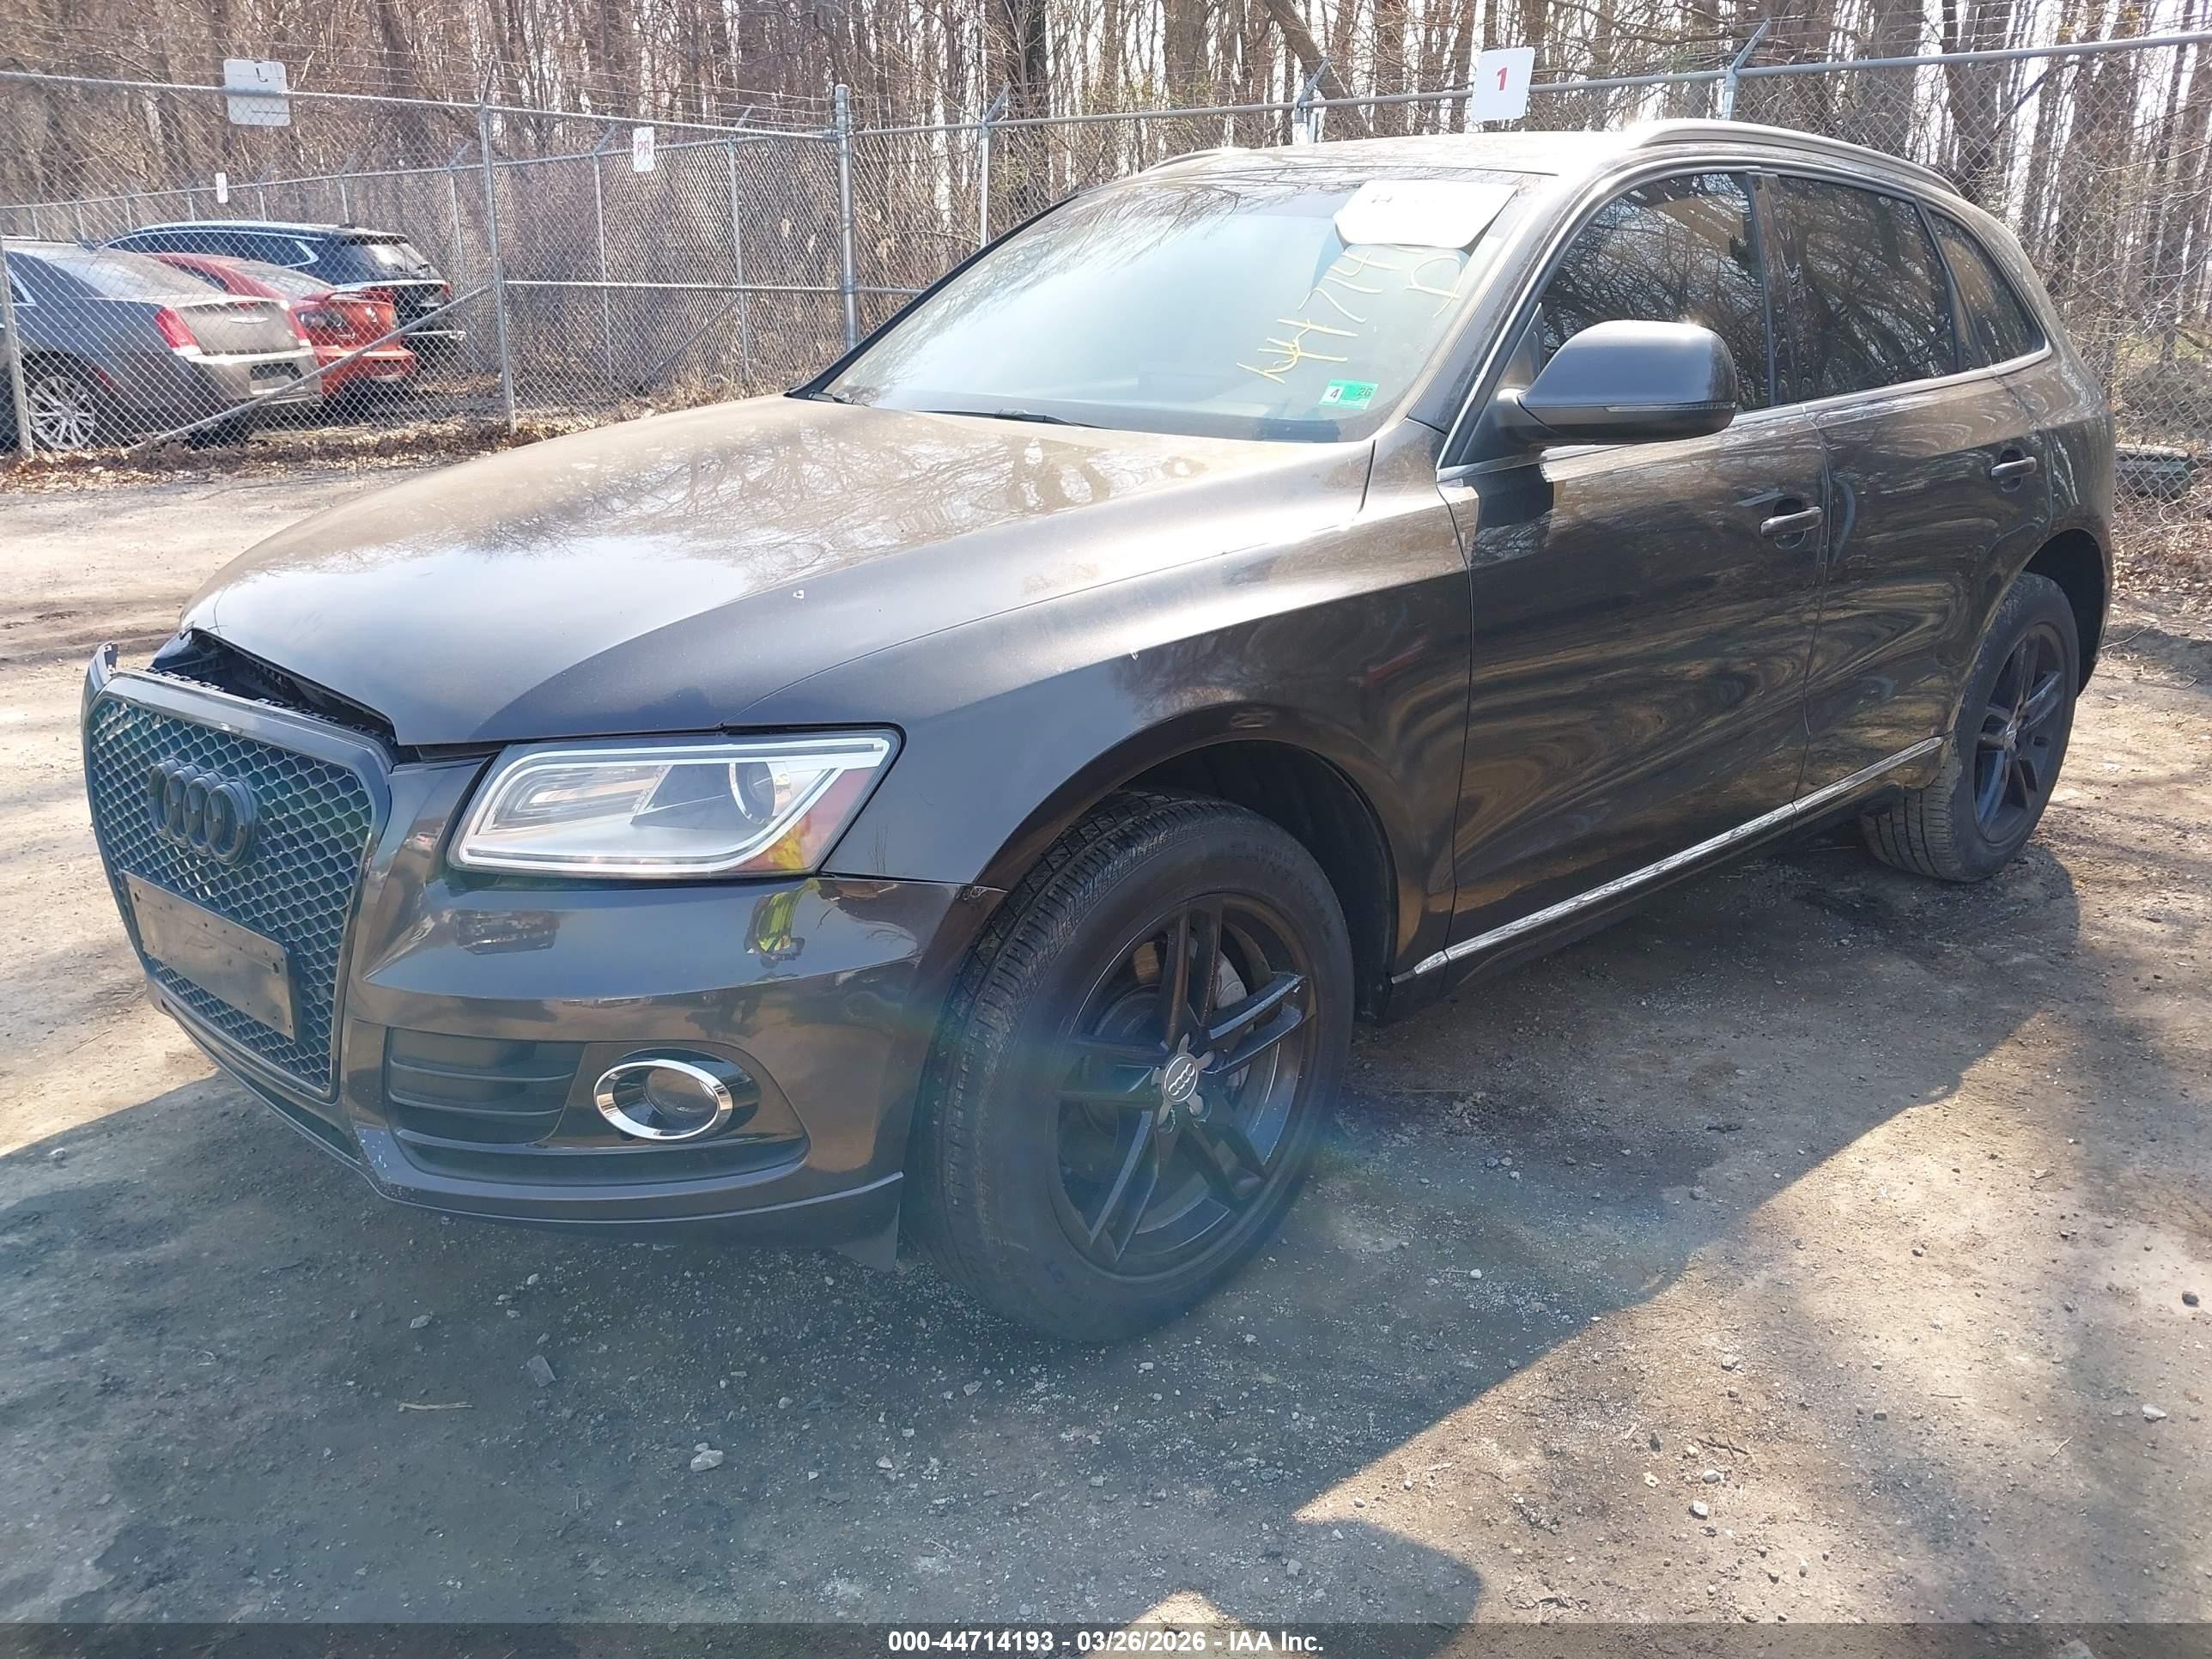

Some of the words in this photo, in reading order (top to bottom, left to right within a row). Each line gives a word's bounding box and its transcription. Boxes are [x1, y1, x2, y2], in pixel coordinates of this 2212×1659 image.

[1495, 66, 1509, 91] 1
[1329, 388, 1340, 399] 4
[1357, 387, 1373, 398] 26
